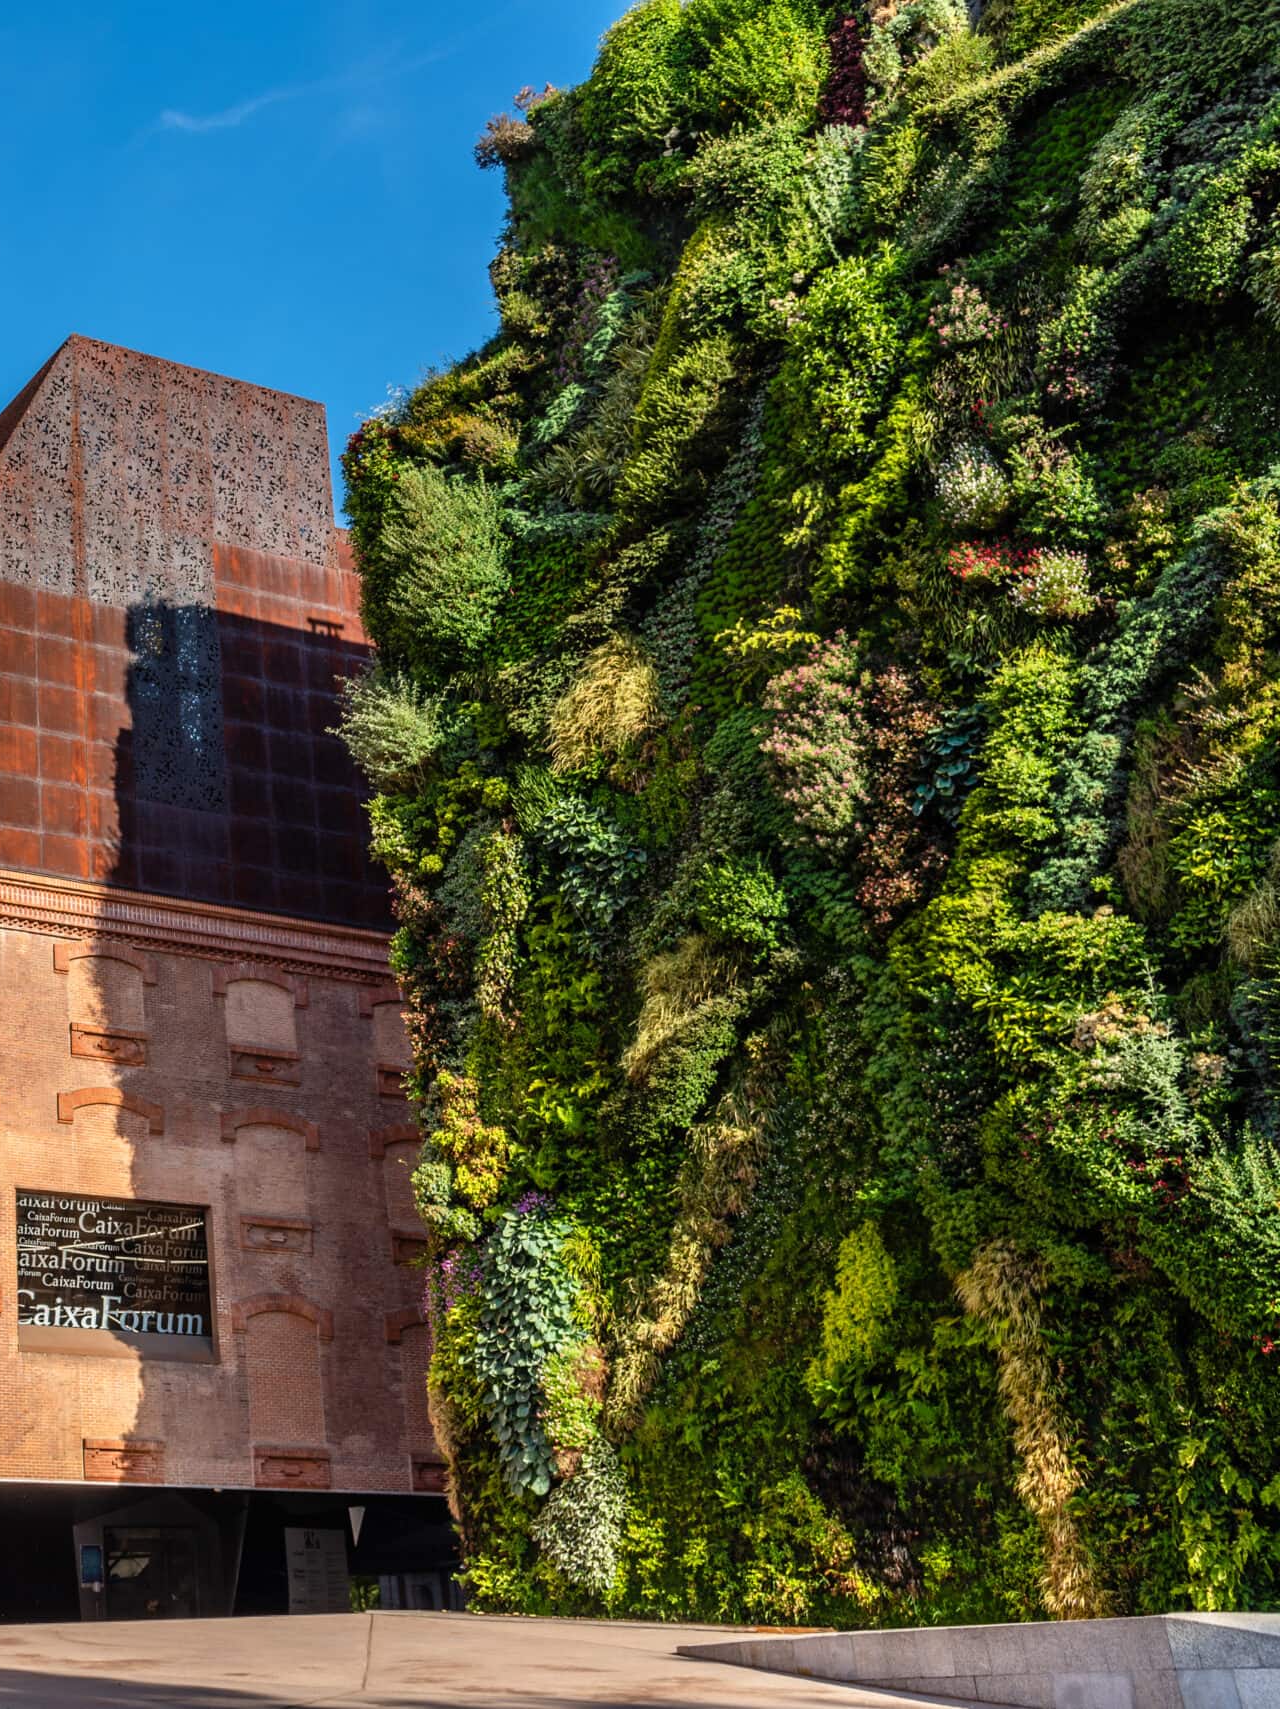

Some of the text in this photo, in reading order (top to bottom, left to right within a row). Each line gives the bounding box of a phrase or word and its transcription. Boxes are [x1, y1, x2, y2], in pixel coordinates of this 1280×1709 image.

[16, 1196, 100, 1213] aixaForum
[27, 1211, 76, 1224] CaixaForum
[78, 1211, 197, 1241] CaixaForum
[17, 1224, 80, 1239] aixaForum
[18, 1248, 126, 1274] aixaForum
[41, 1271, 115, 1291] CaixaForum
